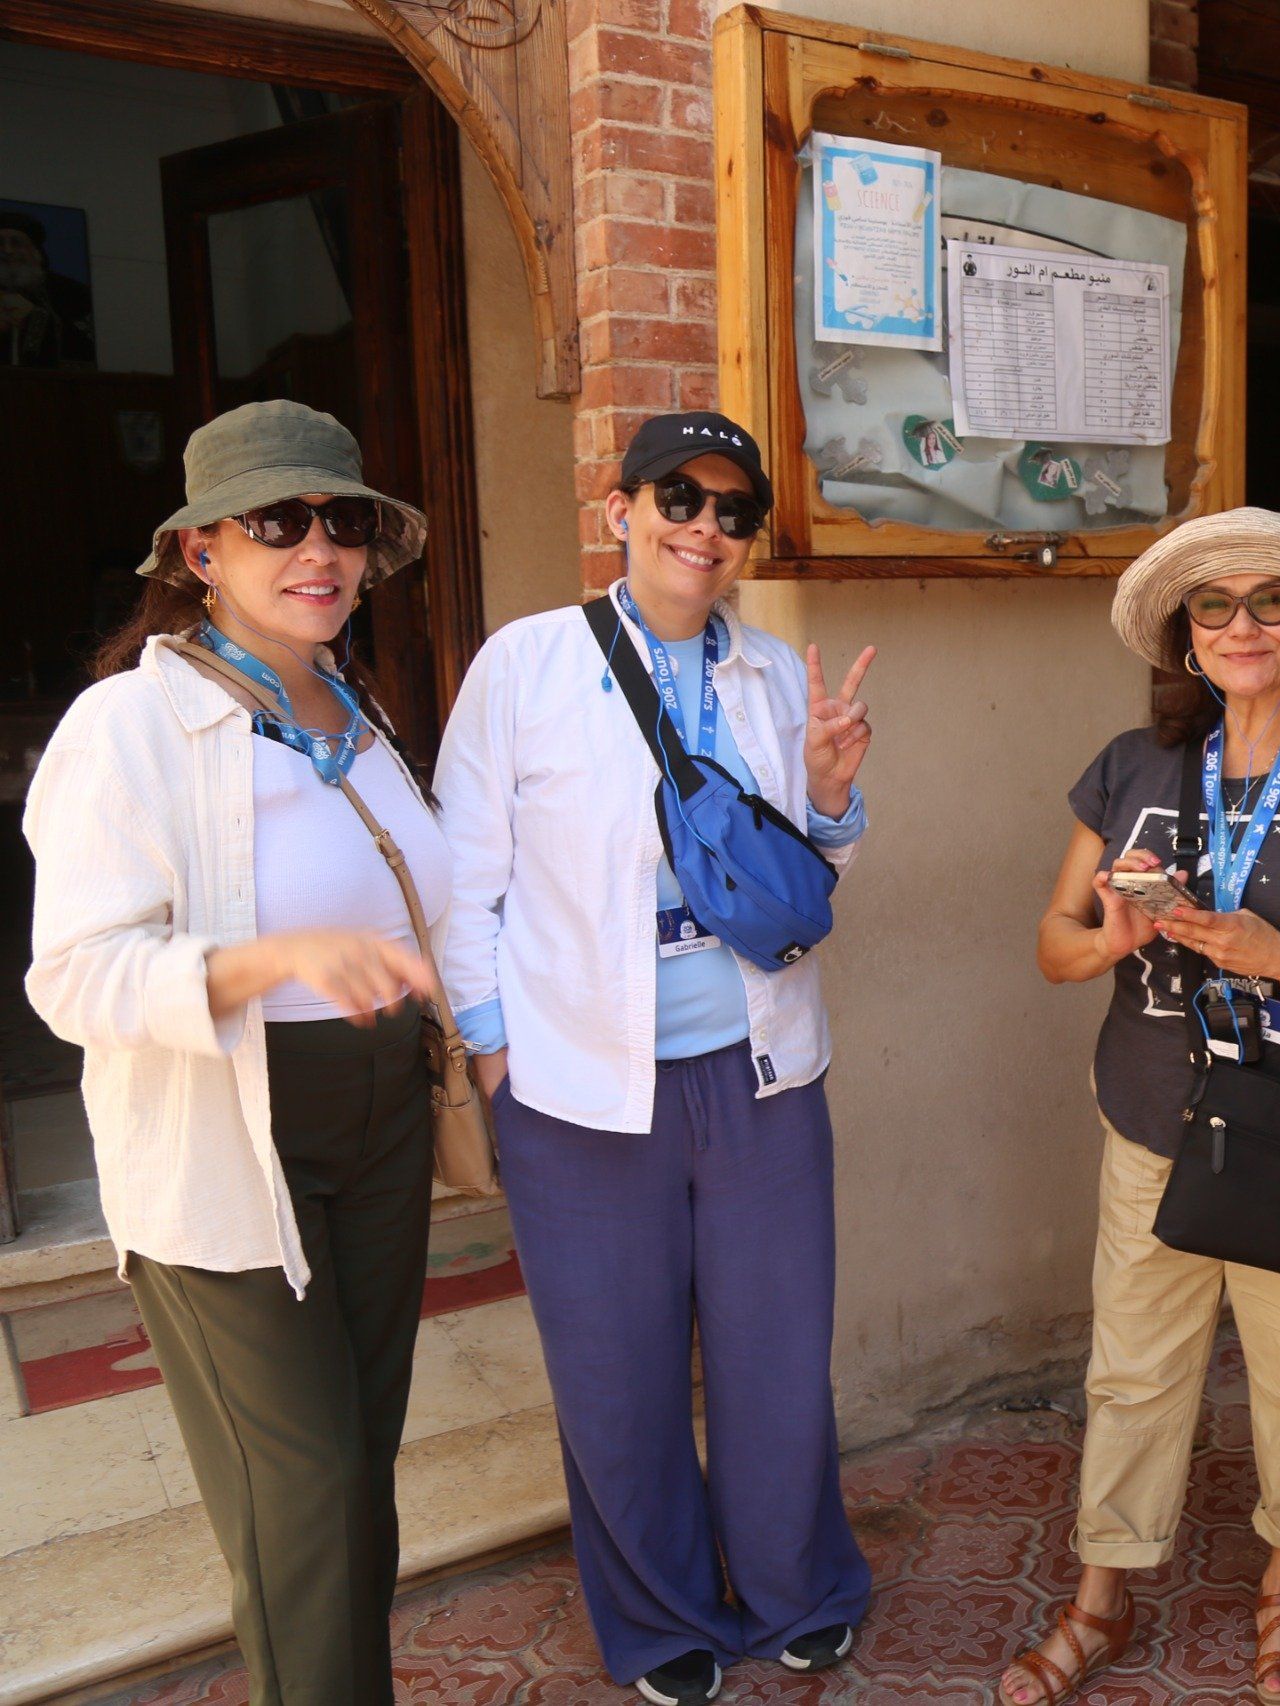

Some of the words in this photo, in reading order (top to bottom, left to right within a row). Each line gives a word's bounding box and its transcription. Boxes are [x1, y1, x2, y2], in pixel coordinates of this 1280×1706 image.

[857, 190, 901, 212] SCIENCE
[653, 646, 671, 686] Tours
[663, 687, 679, 711] 206
[1205, 751, 1218, 772] 206
[1205, 773, 1218, 808] Tours
[1263, 786, 1280, 810] 206
[675, 940, 706, 952] Gabrielle
